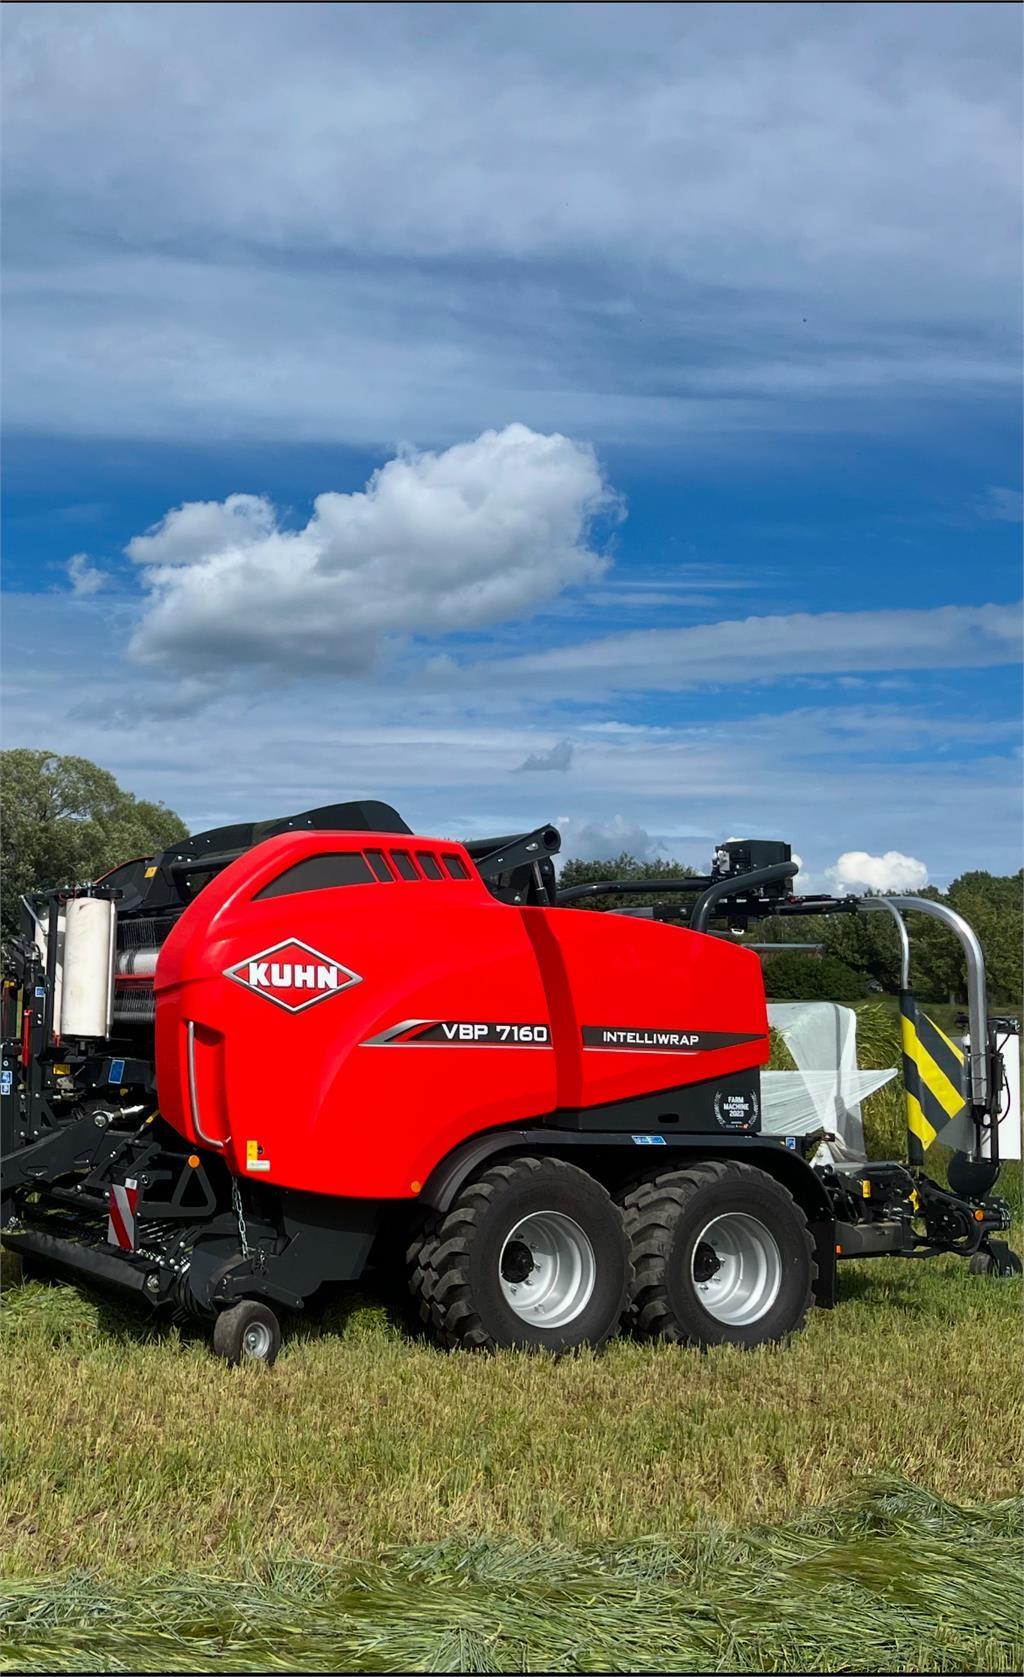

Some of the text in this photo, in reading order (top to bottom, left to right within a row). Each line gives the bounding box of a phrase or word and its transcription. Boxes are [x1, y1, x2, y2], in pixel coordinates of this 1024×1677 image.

[248, 962, 338, 989] KUHN
[441, 1023, 548, 1042] VBP 7160
[603, 1031, 699, 1046] INTELLIWRAP
